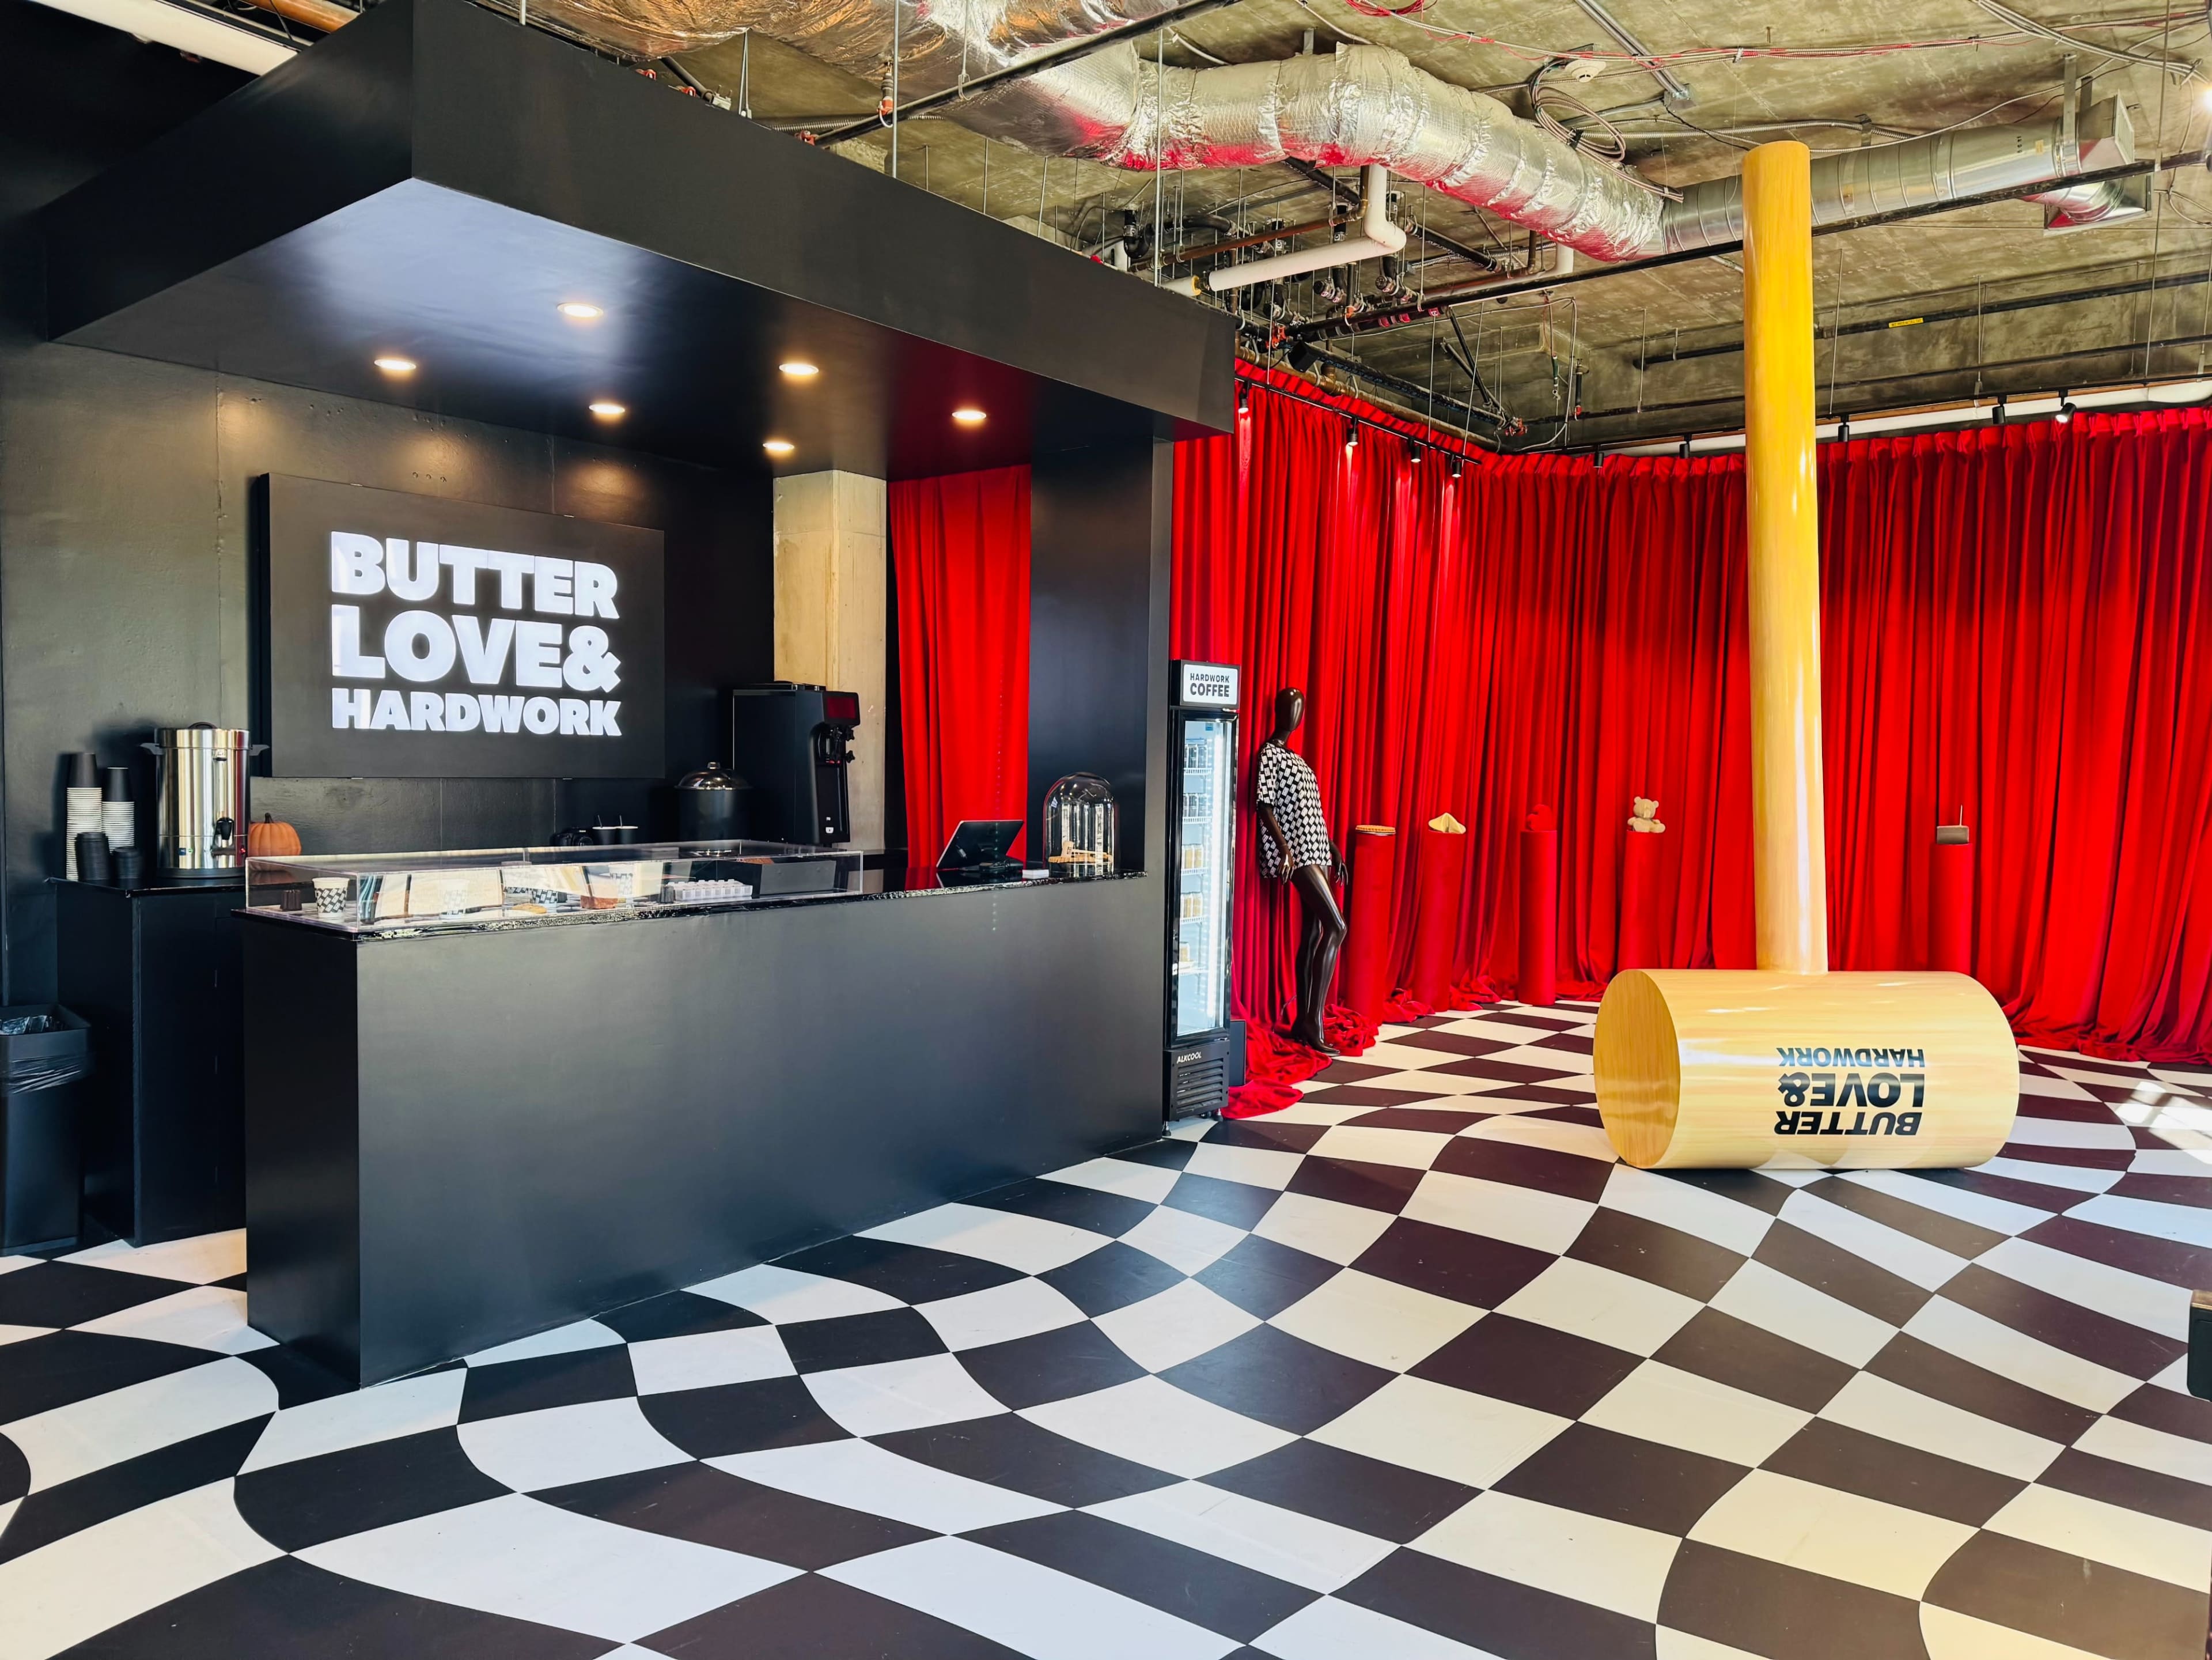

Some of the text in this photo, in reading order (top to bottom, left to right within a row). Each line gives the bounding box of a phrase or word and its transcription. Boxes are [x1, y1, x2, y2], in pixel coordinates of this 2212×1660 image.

[331, 531, 620, 619] BUTTER
[331, 603, 622, 693] LOVE&
[1190, 672, 1230, 683] HARDWORK
[1190, 683, 1230, 697] COFFEE
[331, 687, 623, 736] HARDWORK
[1776, 1047, 1925, 1067] HARDWORK
[1778, 1072, 1925, 1108] LOVE&
[1774, 1111, 1923, 1136] BUTTER
